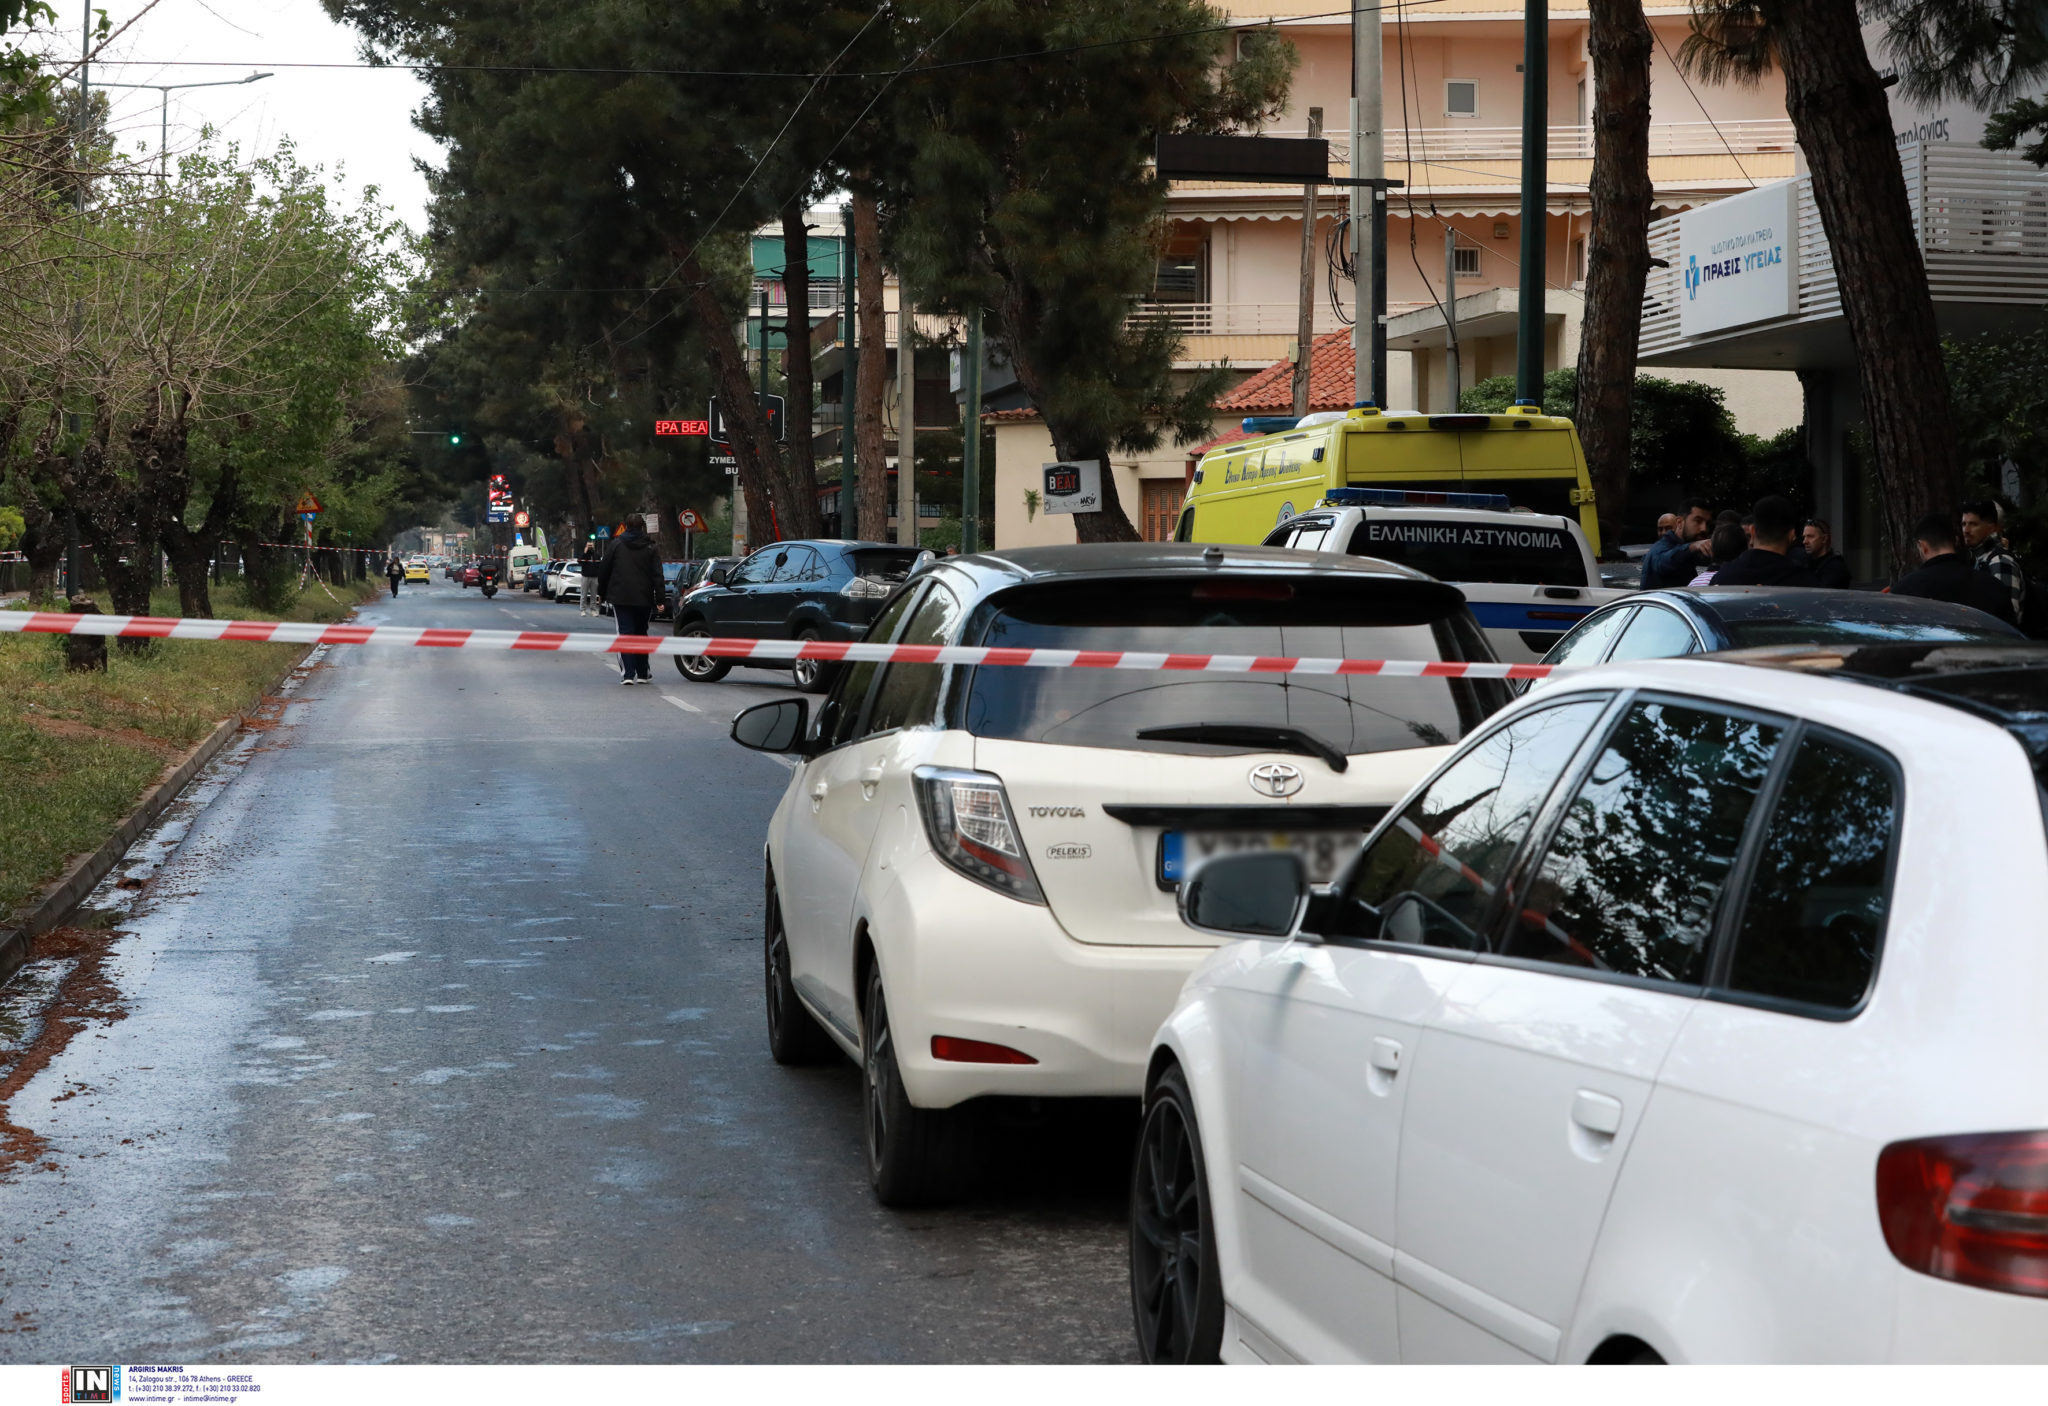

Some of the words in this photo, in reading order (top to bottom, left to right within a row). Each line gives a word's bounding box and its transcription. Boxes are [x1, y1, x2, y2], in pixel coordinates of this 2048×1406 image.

[1703, 257, 1741, 282] ΠΡΑΞΙΣ
[1743, 246, 1782, 272] ΥΓΕΙΑΣ
[709, 456, 736, 464] ΖΥΜΕΣ
[1049, 474, 1076, 490] BEAT
[1369, 525, 1457, 544] ΕΛΛΗΝΙΚΗ
[1461, 529, 1562, 549] ΑΣΤΥΝΟΜΙΑ
[1028, 806, 1085, 818] TOYOTA
[1050, 847, 1087, 856] PELEKIS
